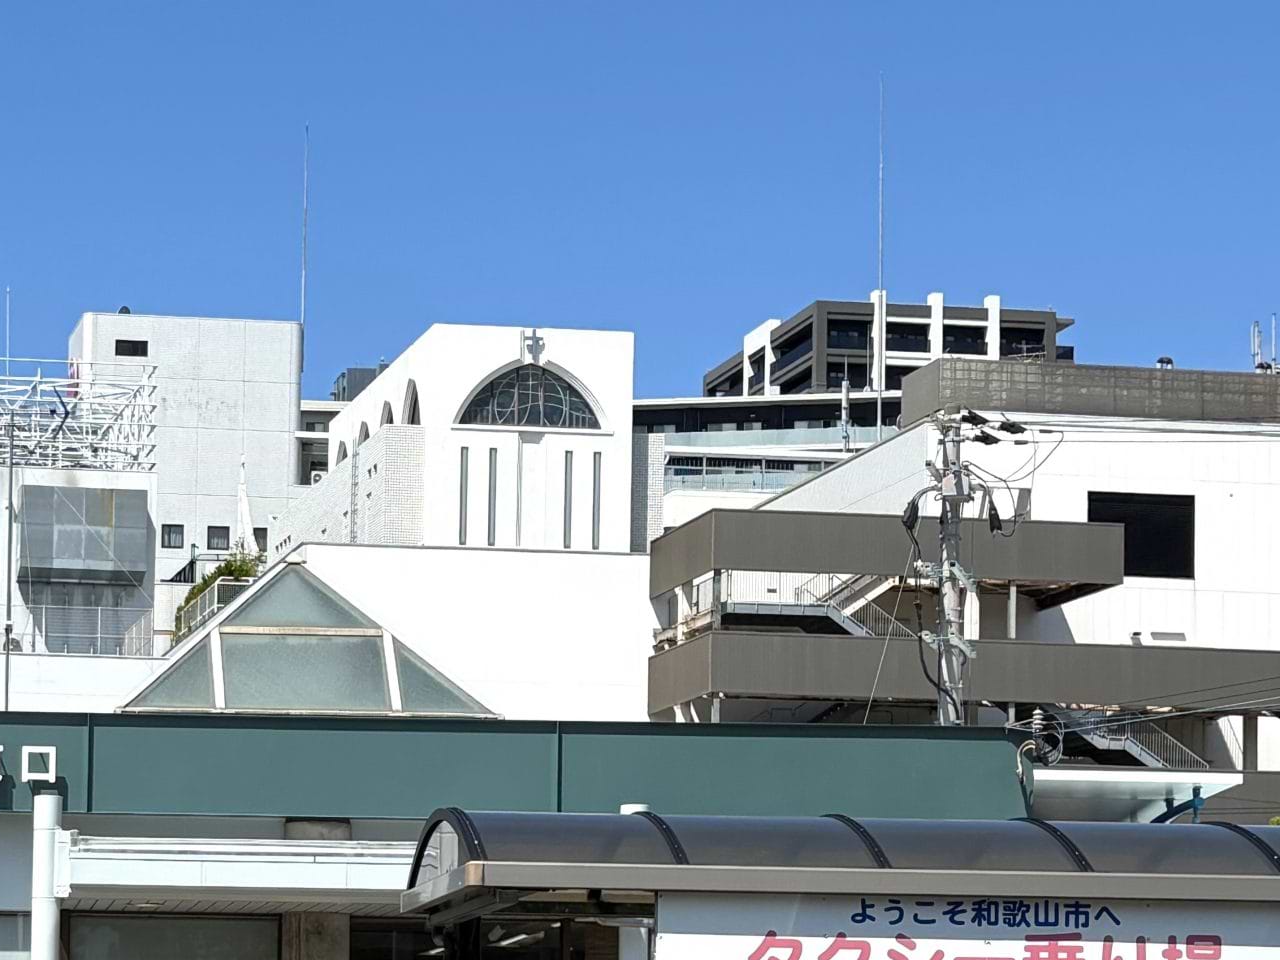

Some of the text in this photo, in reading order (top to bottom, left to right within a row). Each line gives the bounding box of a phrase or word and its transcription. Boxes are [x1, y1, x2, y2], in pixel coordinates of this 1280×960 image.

[849, 899, 1122, 930] ようこそ和歌山市へ
